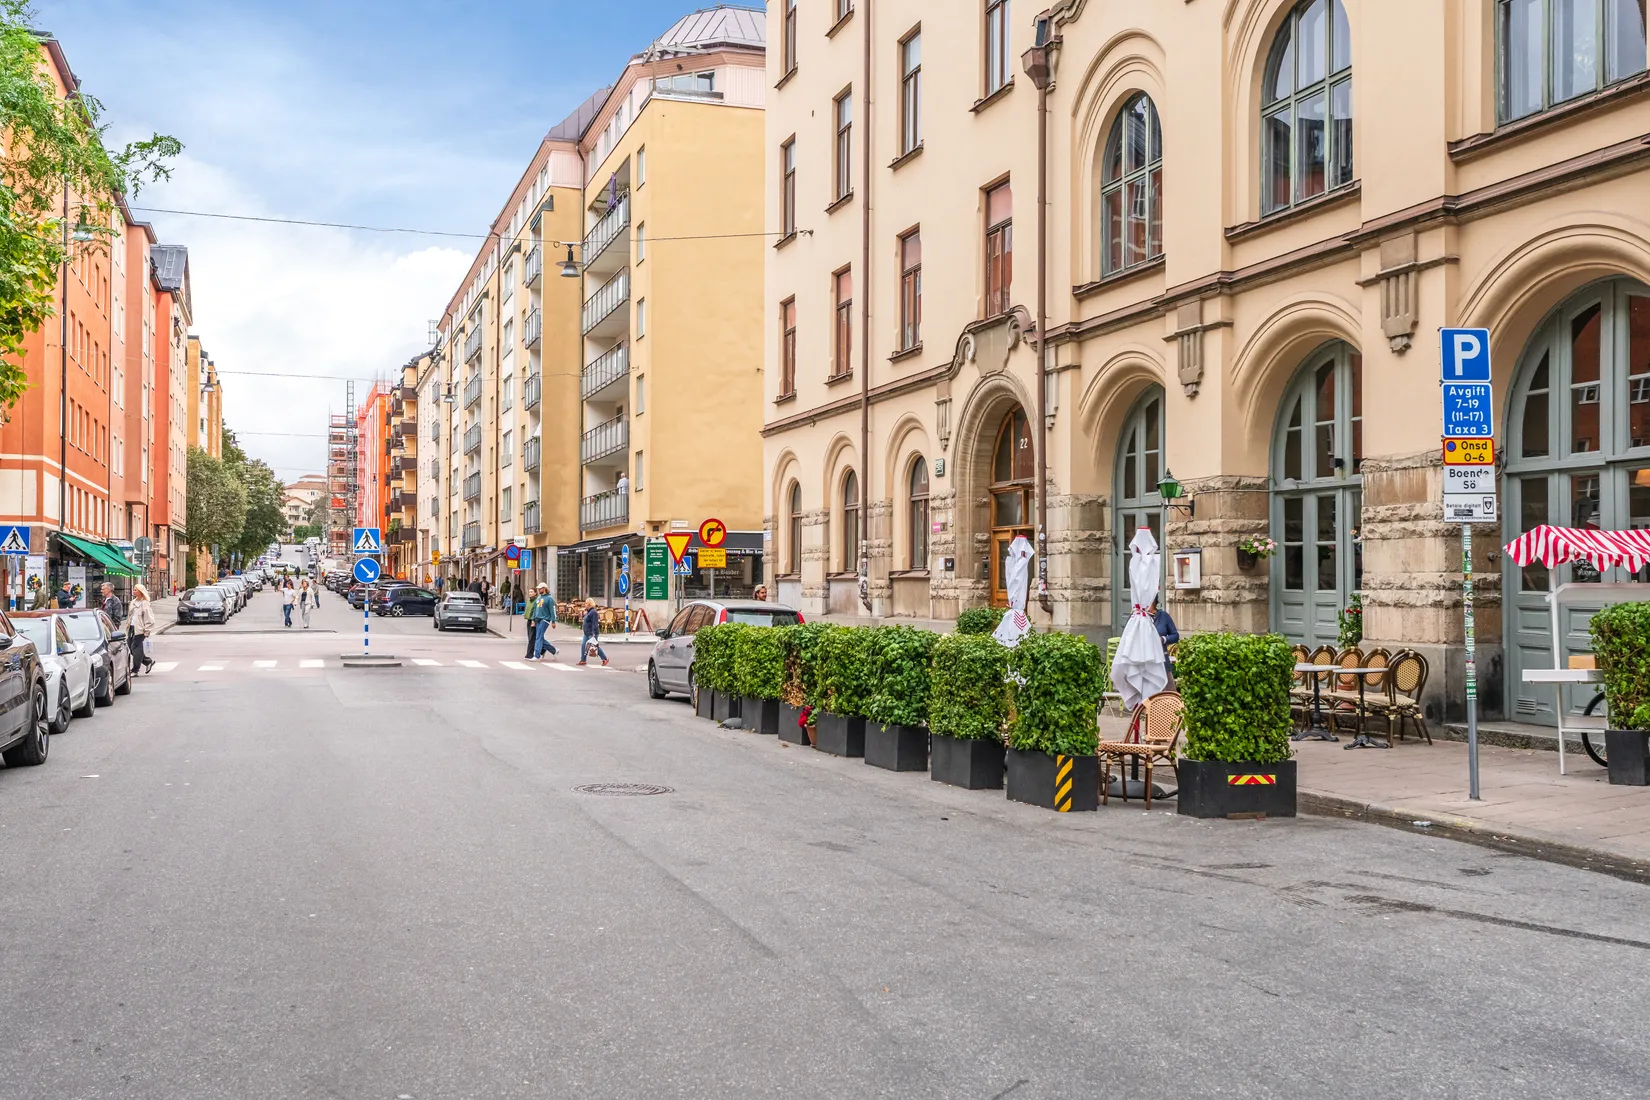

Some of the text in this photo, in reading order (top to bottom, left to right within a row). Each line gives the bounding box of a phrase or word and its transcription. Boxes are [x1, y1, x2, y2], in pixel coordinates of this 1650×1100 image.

[1453, 334, 1481, 376] P
[1449, 386, 1485, 398] Avgift
[1455, 399, 1479, 408] 7-19
[1451, 411, 1484, 422] (11-17)
[1448, 424, 1488, 434] Taxa 3
[1020, 437, 1028, 449] 22
[1461, 441, 1488, 450] Onsd
[1464, 452, 1485, 462] 0-6
[1463, 480, 1476, 489] Sö
